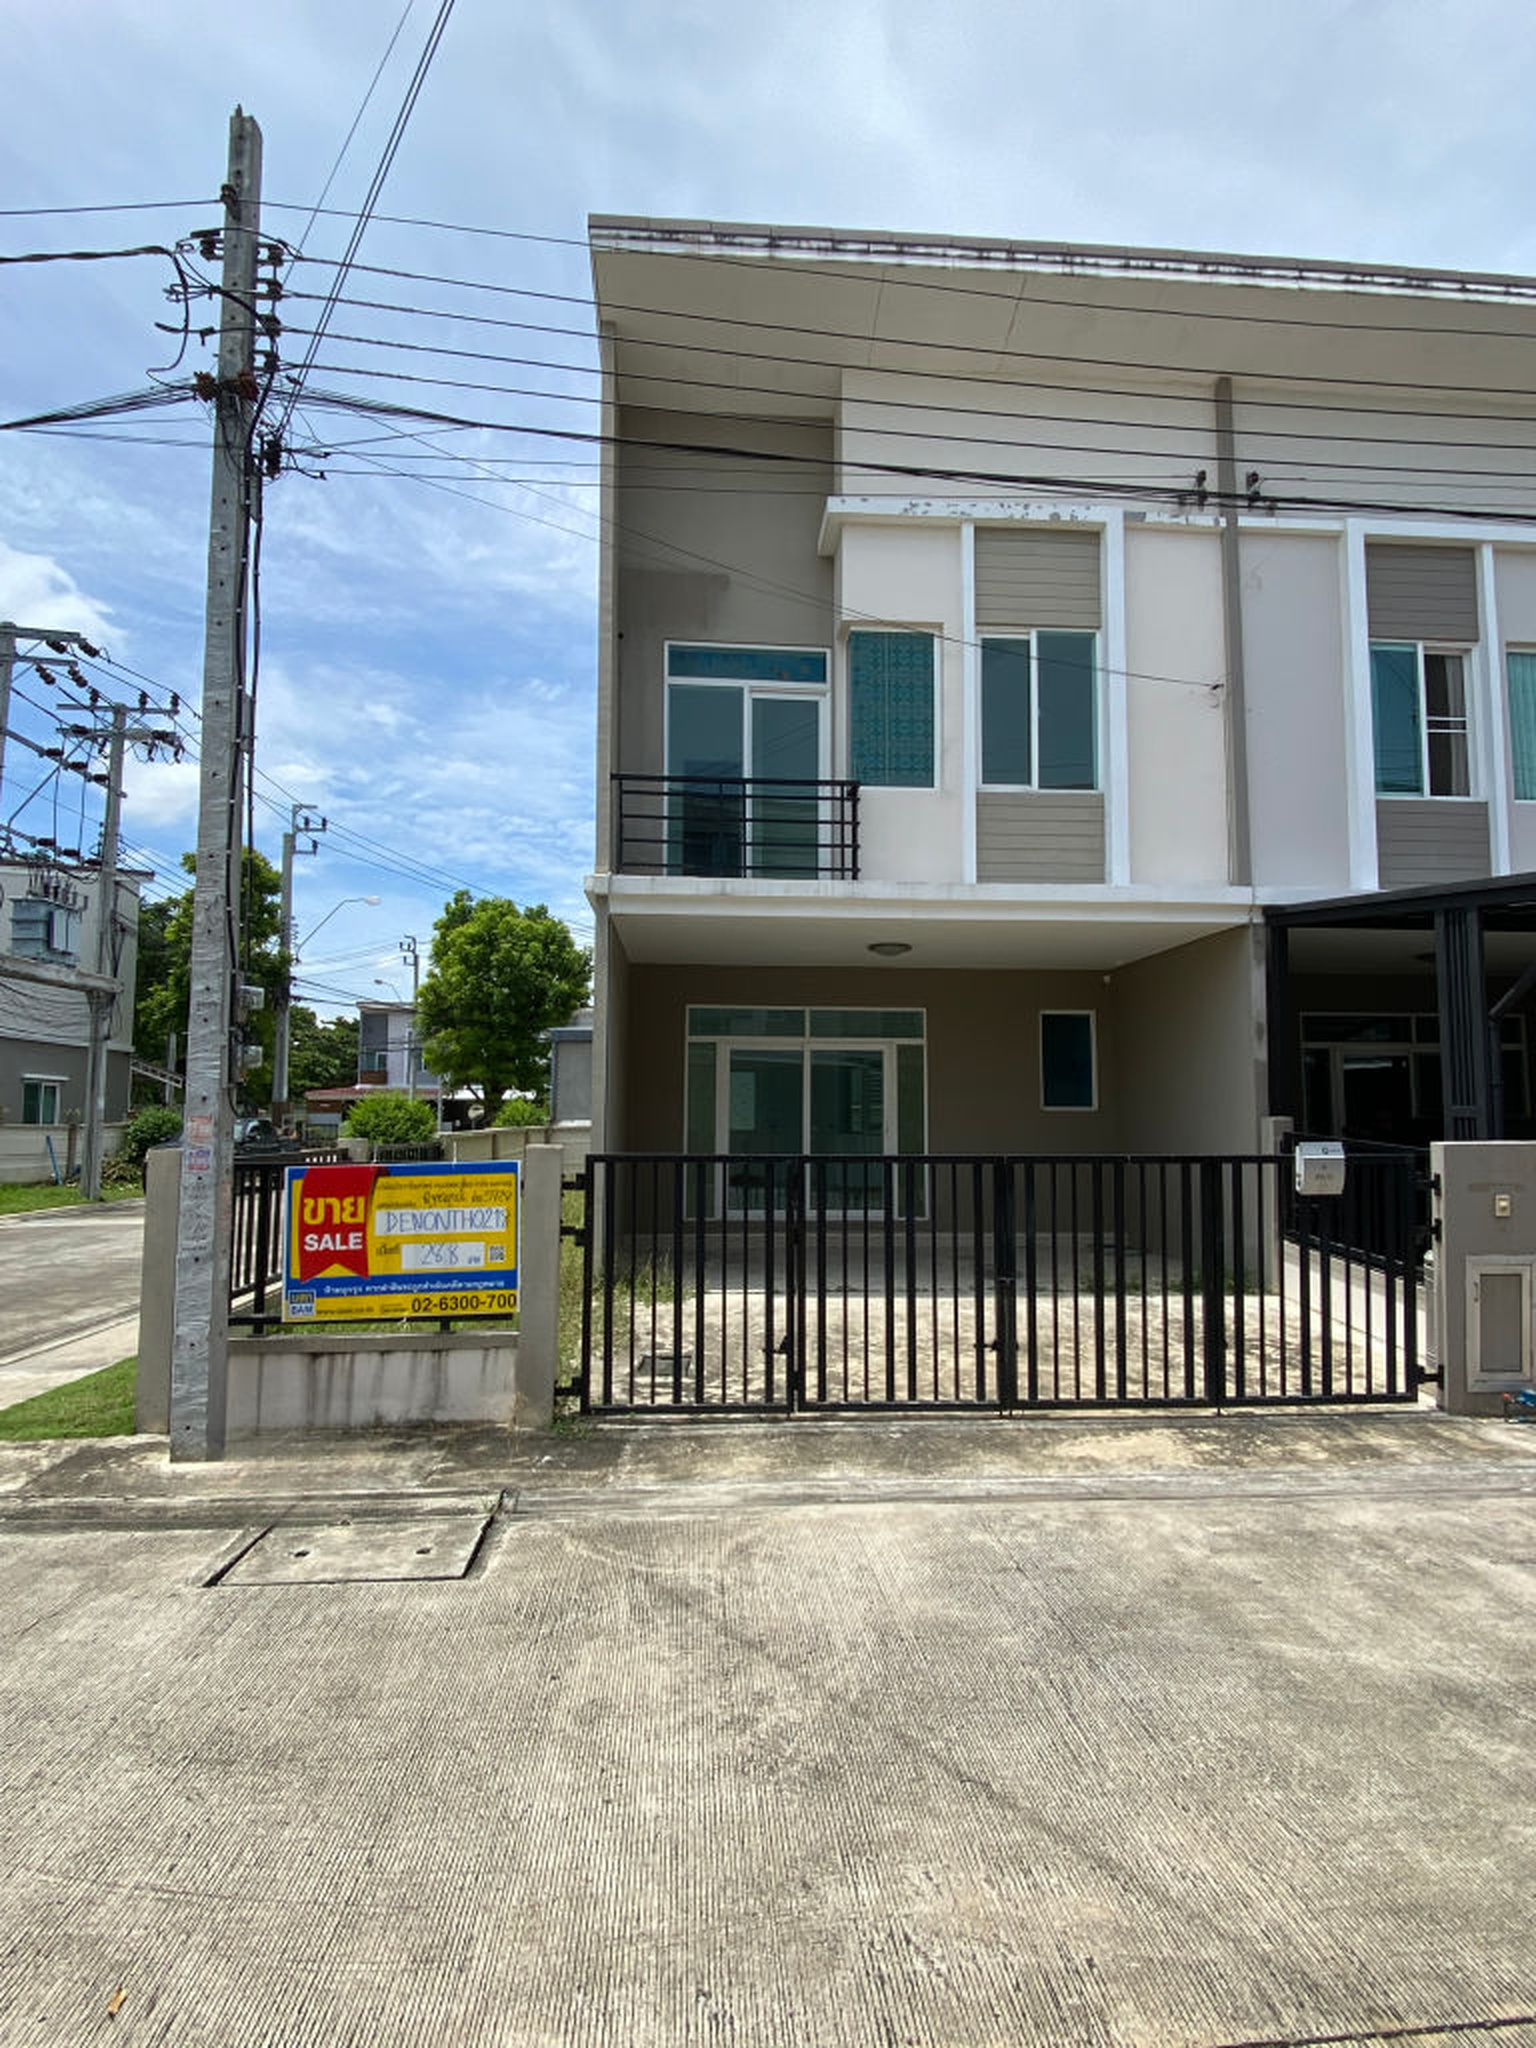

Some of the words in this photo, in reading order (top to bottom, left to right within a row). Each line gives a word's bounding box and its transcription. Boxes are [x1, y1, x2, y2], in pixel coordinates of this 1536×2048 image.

[303, 1196, 365, 1225] ขาย
[303, 1231, 363, 1251] SALE
[411, 1293, 517, 1312] 02-6300-700
